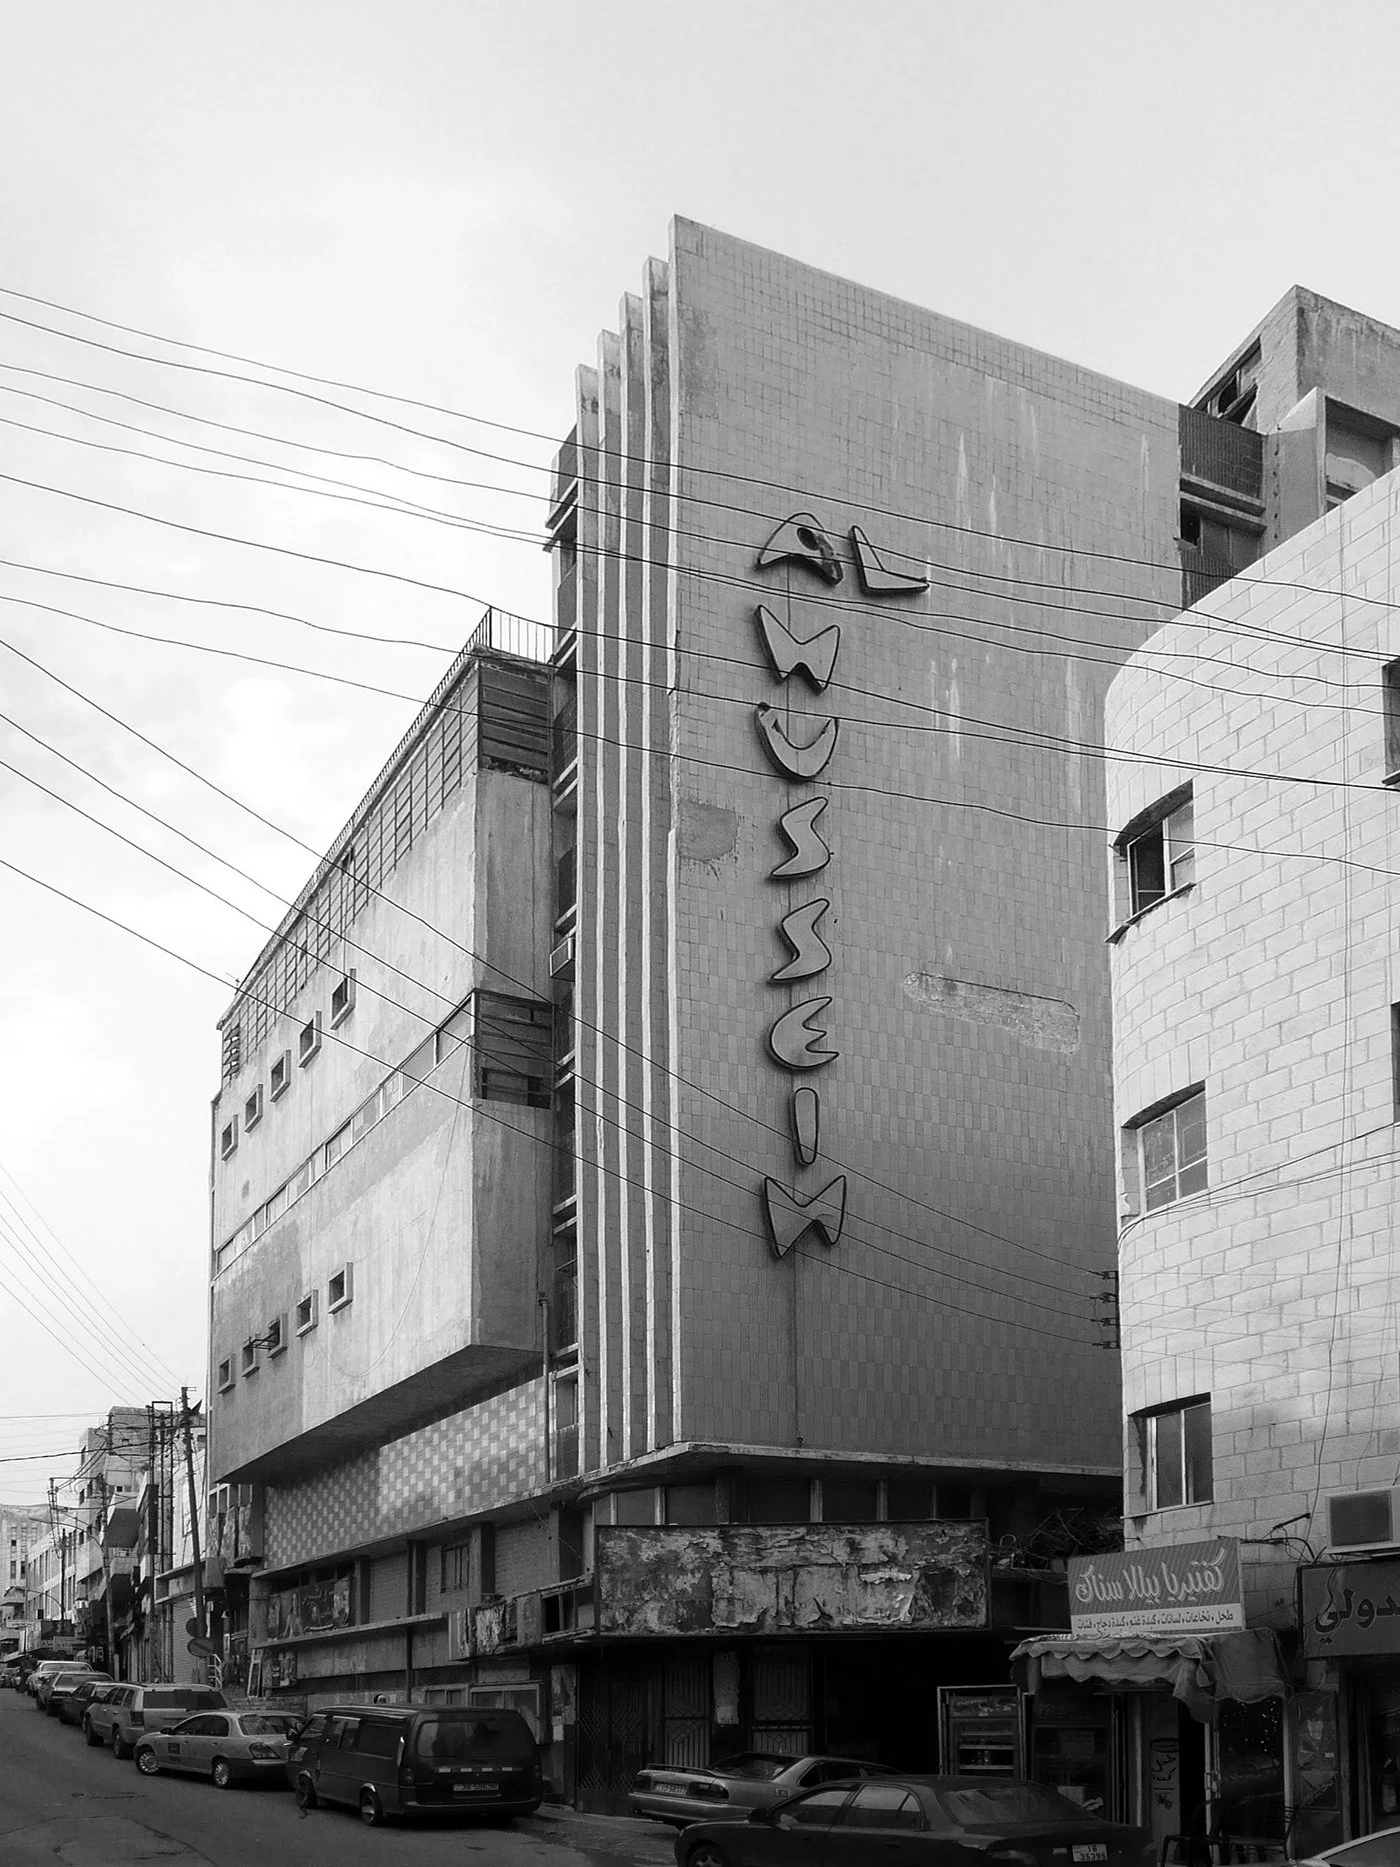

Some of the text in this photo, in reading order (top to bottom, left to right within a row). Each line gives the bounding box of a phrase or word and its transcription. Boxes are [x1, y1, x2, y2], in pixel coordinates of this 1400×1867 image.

[756, 511, 931, 595] AL
[1075, 1564, 1123, 1604] سناك
[1161, 1547, 1226, 1603] كفتيريا
[1315, 1588, 1400, 1645] دولي
